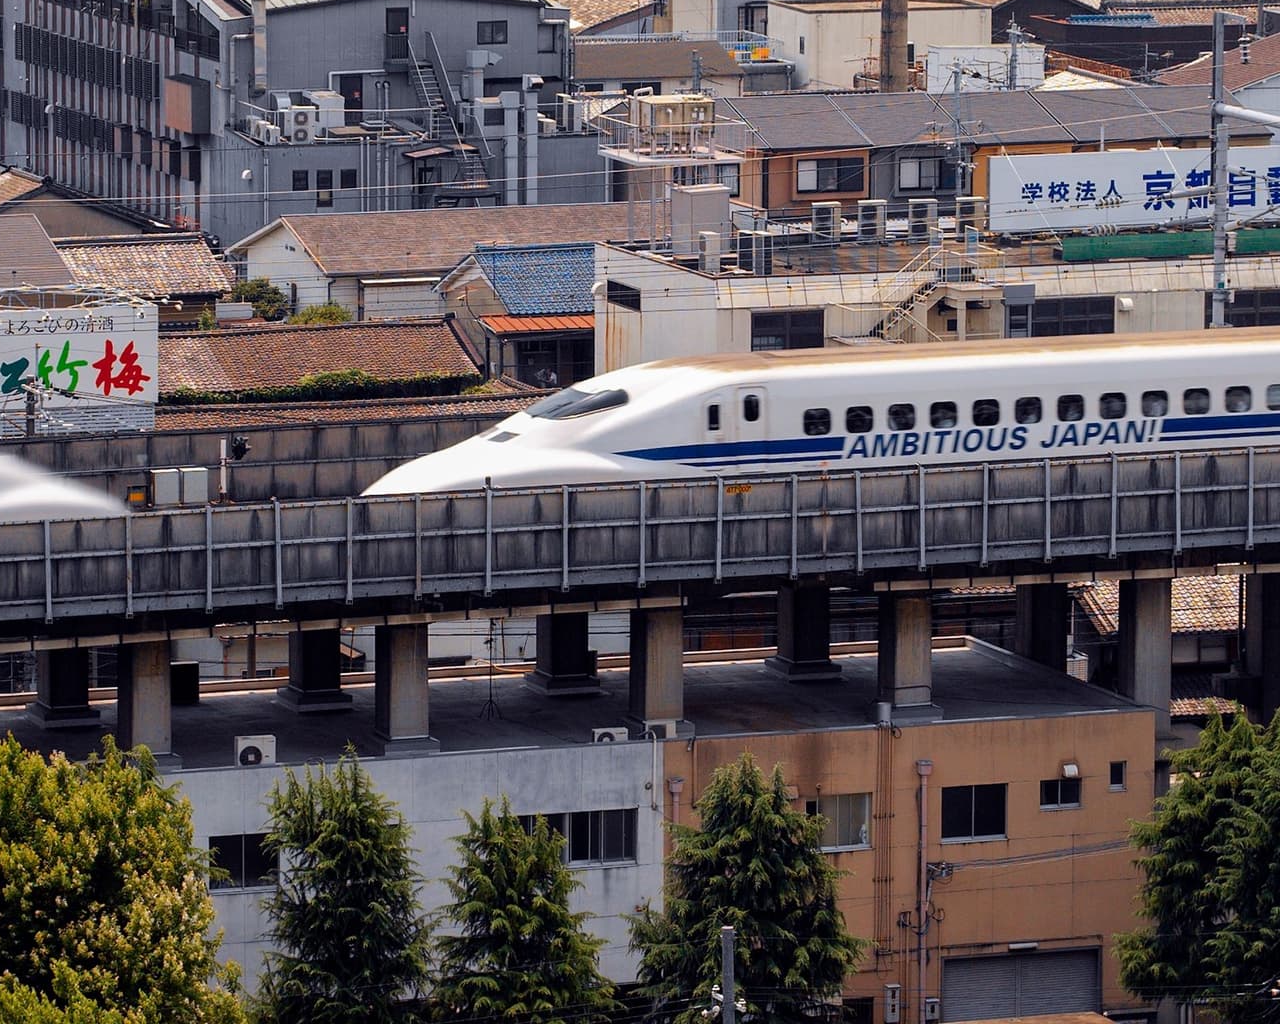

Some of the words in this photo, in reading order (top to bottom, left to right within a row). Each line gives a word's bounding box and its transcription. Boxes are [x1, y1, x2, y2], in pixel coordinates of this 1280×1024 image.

[1022, 179, 1123, 204] 学校法人
[4, 316, 114, 335] よろこびの清酒
[846, 426, 1028, 459] AMBITIOUS
[1040, 420, 1156, 449] JAPAN!
